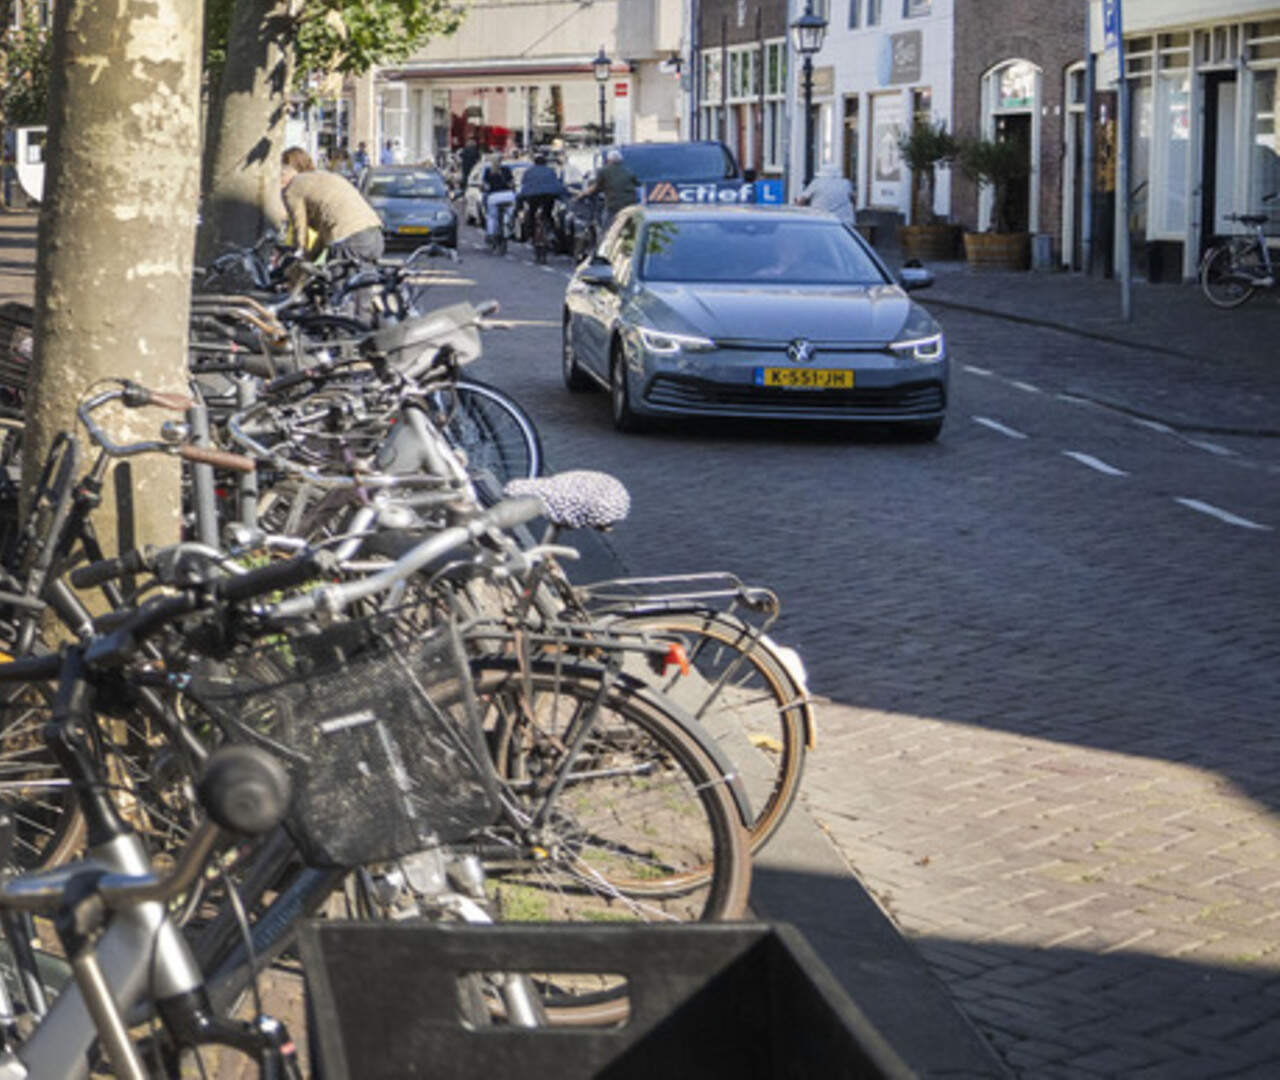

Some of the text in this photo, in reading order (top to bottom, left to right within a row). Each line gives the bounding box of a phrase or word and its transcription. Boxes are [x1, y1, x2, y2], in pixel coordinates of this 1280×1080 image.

[648, 181, 776, 202] Actief L
[771, 369, 846, 386] K-551-JH
